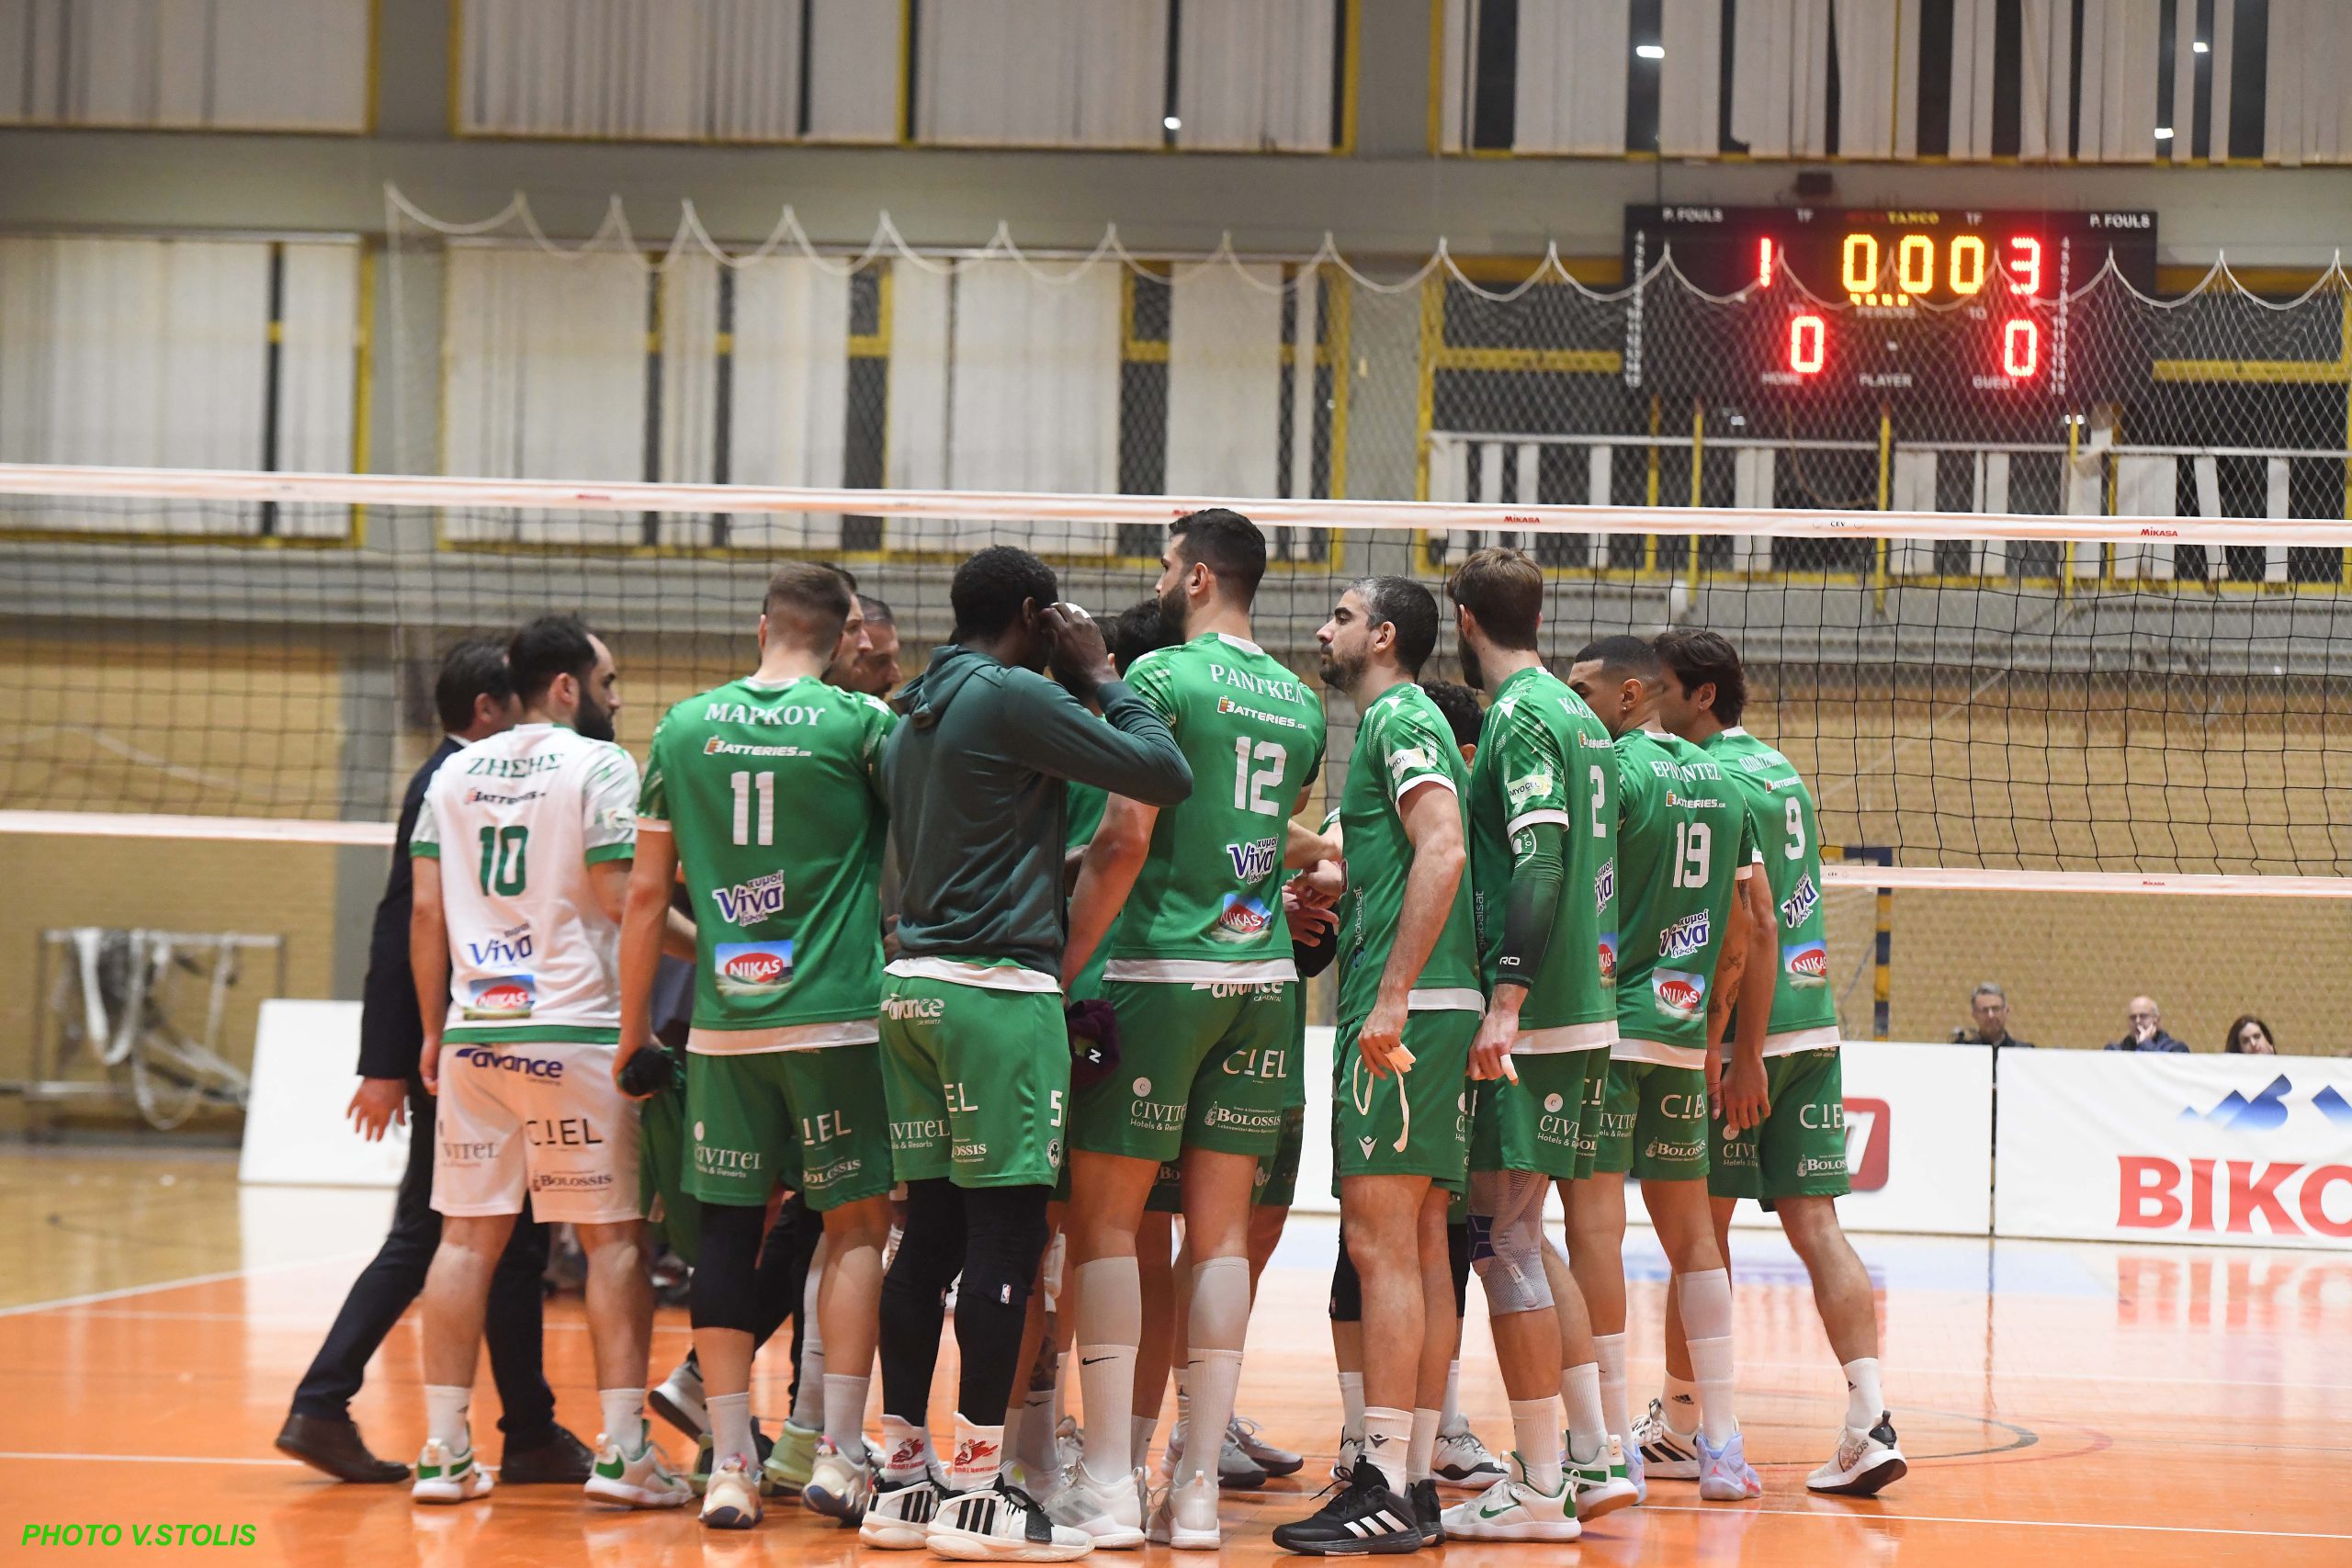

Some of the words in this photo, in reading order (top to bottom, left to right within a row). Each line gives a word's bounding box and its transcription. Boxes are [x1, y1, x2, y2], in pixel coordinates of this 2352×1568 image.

[1677, 208, 1724, 222] FOULS
[2104, 214, 2150, 228] FOULS
[1759, 238, 1771, 288] 1
[2010, 237, 2041, 295] 3
[1791, 316, 1825, 373] 0
[2004, 320, 2038, 377] 0
[1859, 373, 1912, 387] PLAYER
[1973, 378, 2019, 390] GUEST
[1234, 736, 1287, 817] 12
[730, 770, 775, 846] 11
[1589, 764, 1607, 838] 2
[1784, 796, 1806, 861] 9
[480, 825, 529, 897] 10
[1228, 845, 1275, 876] Viva
[1673, 821, 1712, 888] 19
[1221, 910, 1262, 927] NIKAS
[1355, 886, 1364, 946] globalsat
[1475, 890, 1488, 950] globalsat
[1660, 923, 1708, 955] Viva
[729, 958, 781, 977] NIKAS
[1599, 952, 1611, 968] IKAS
[1662, 986, 1699, 1004] NIKAS
[471, 1050, 564, 1078] avance
[1222, 1048, 1286, 1079] CIEL
[1050, 1089, 1063, 1127] 5
[1130, 1117, 1155, 1129] Hotels
[1217, 1108, 1282, 1126] BOLOSSIS
[1799, 1103, 1845, 1129] CIE
[526, 1118, 604, 1145] CIEL
[802, 1110, 852, 1146] IEL
[1537, 1133, 1562, 1145] Hotels
[1807, 1159, 1847, 1171] BOLOS
